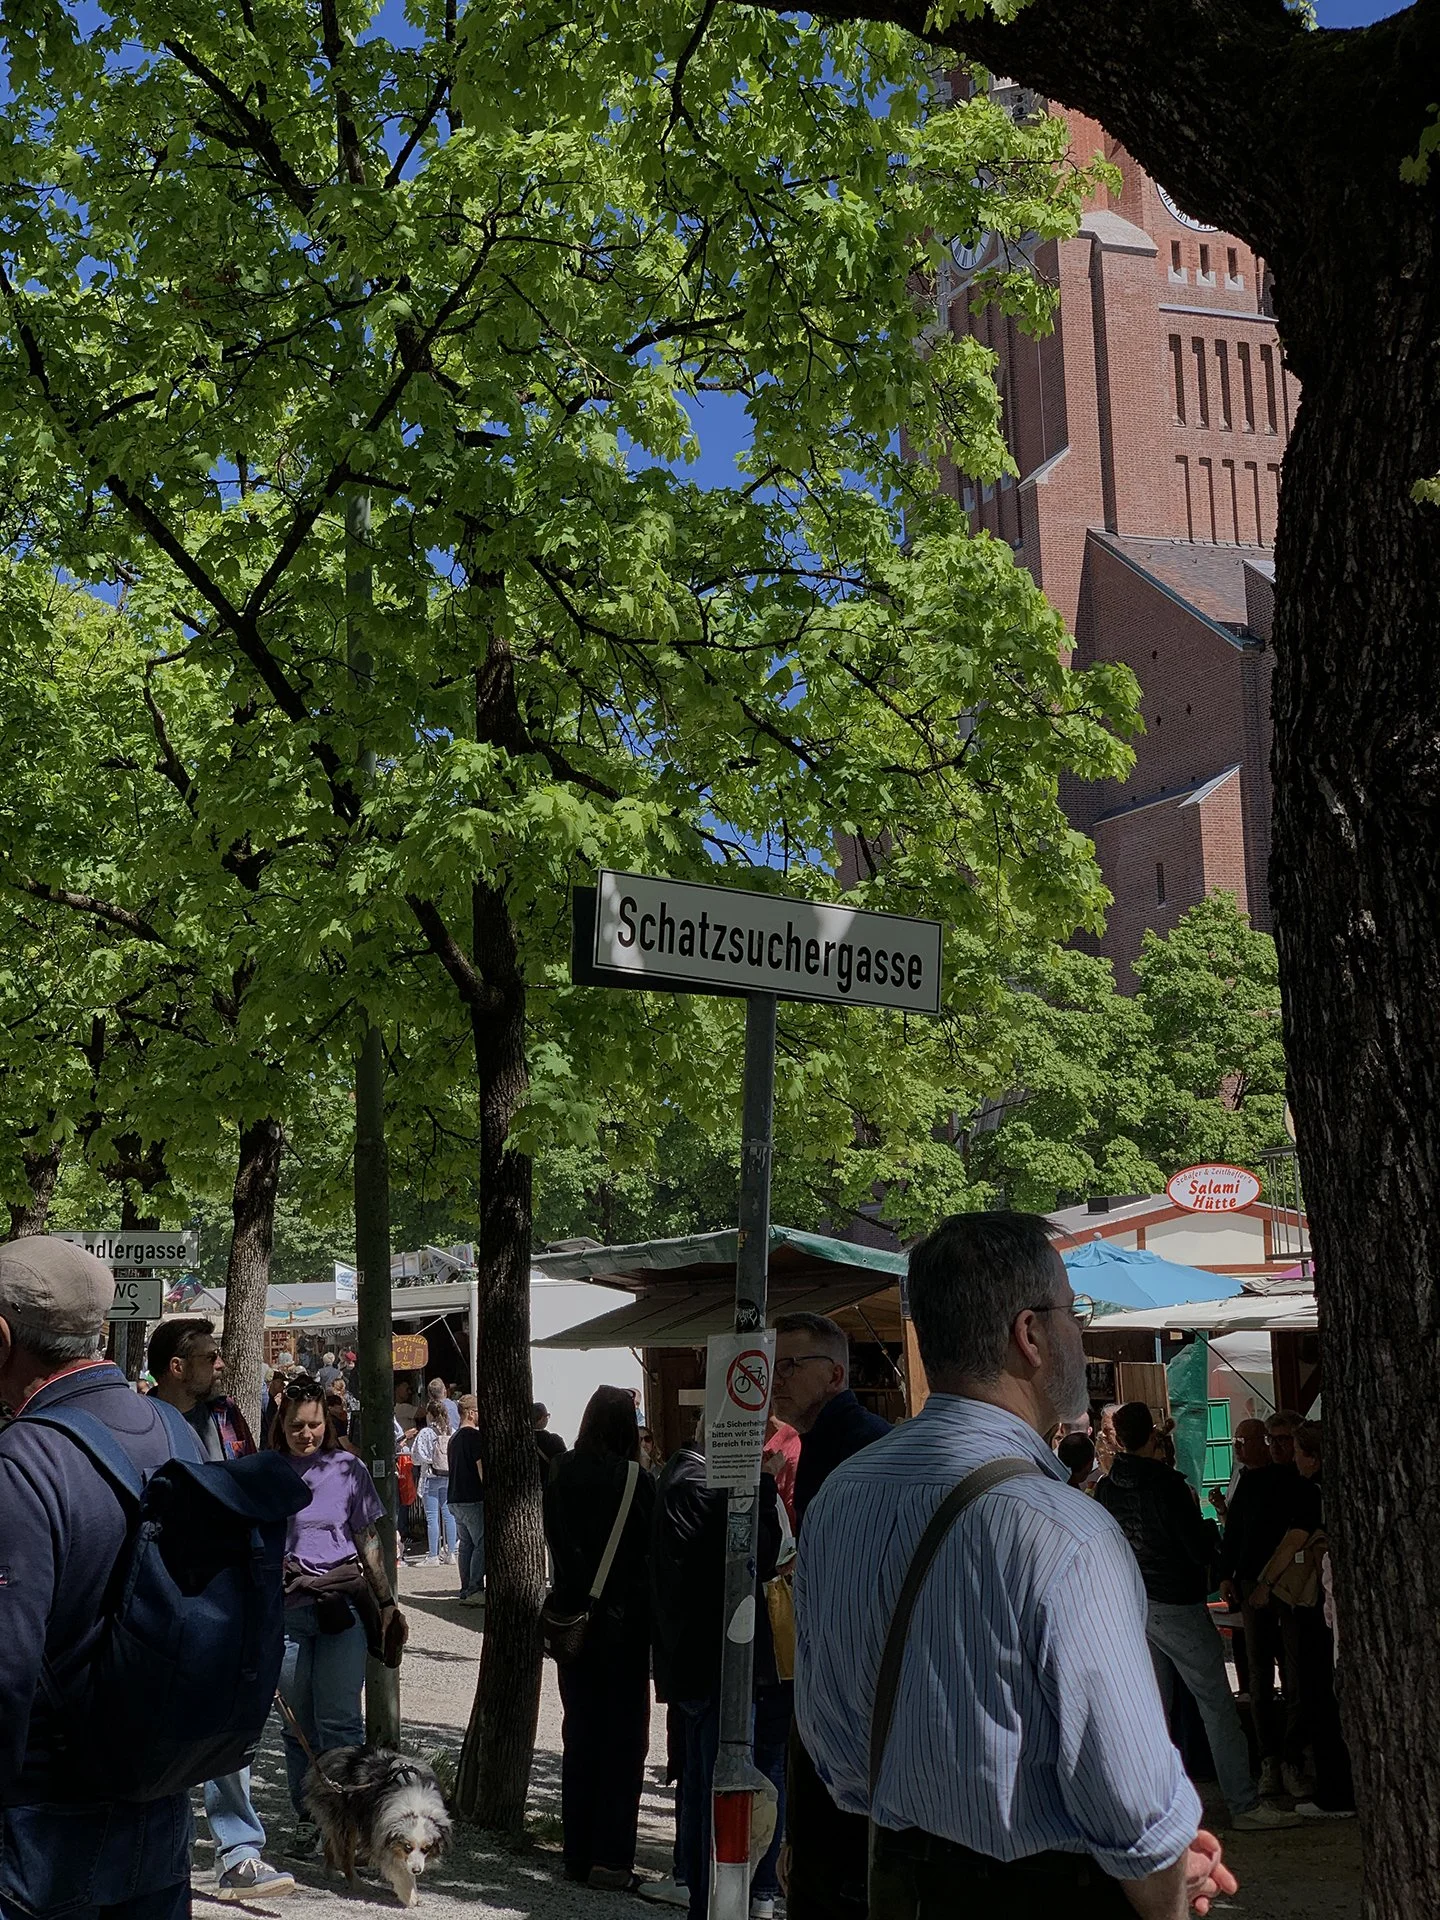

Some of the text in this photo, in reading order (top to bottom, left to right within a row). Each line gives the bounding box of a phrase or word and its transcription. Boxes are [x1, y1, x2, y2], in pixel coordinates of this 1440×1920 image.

[617, 895, 923, 994] Schatzsuchergasse
[1188, 1178, 1241, 1195] Salami
[1192, 1195, 1237, 1210] Hütte
[64, 1238, 187, 1264] ndlergasse
[114, 1283, 139, 1299] WC
[712, 1421, 725, 1429] Aus
[712, 1440, 739, 1448] Bereich
[741, 1439, 753, 1447] frei
